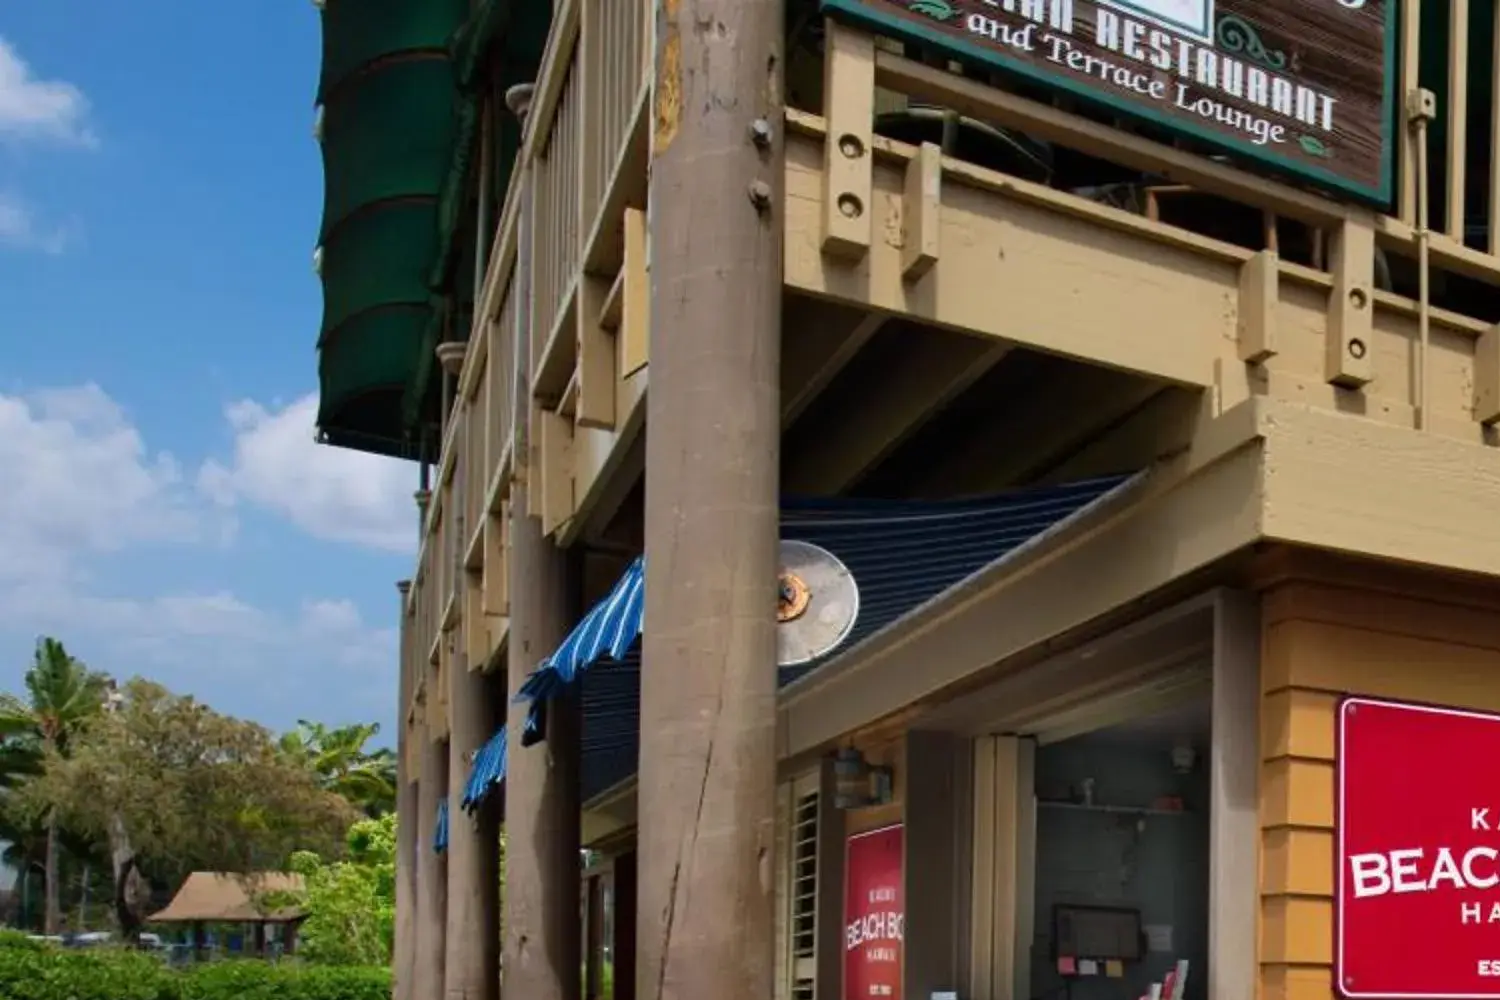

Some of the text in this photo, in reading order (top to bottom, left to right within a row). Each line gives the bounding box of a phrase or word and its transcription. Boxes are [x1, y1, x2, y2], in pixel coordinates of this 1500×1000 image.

[967, 13, 1286, 145] and Terrace Lounge
[1096, 8, 1337, 131] RESTAURANT
[846, 912, 885, 950] BEACH
